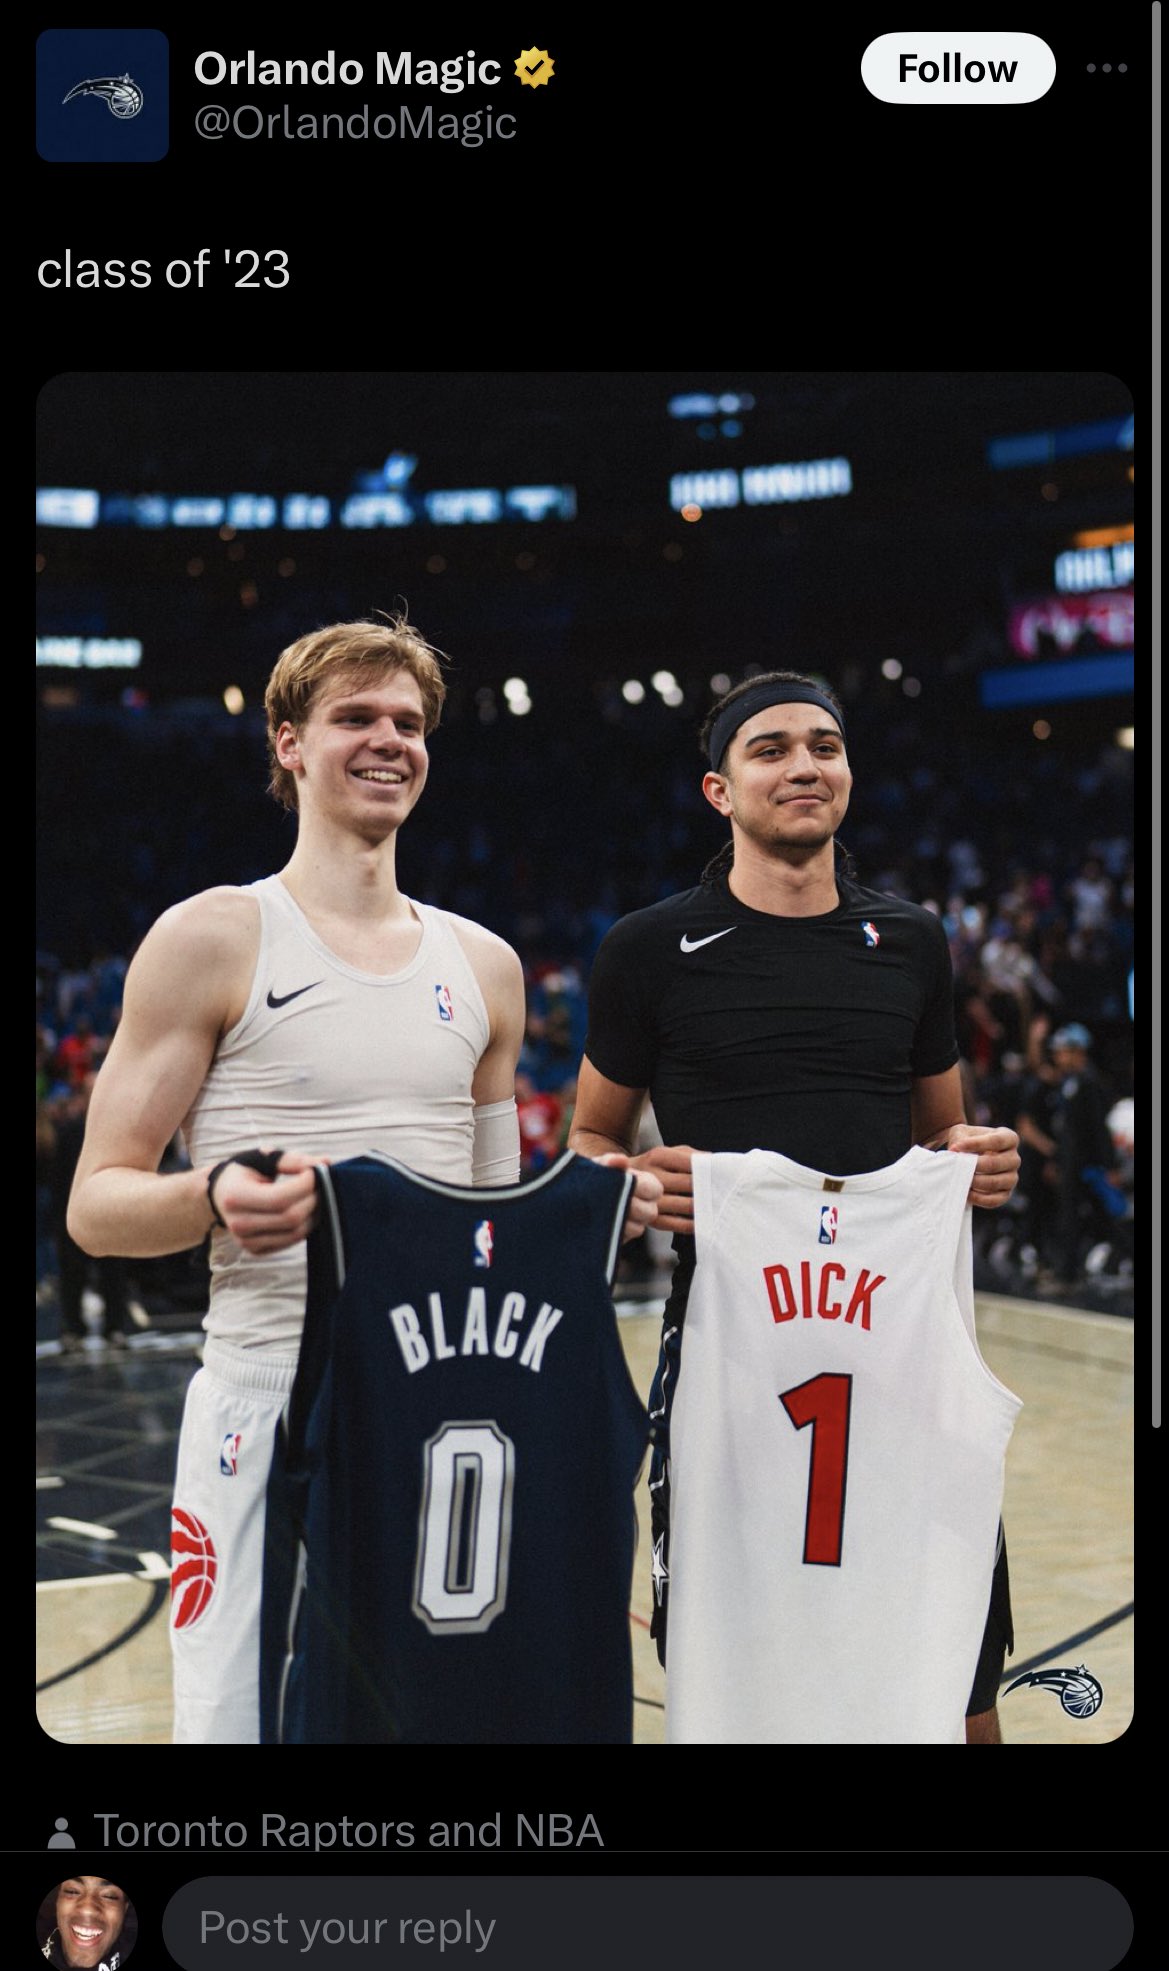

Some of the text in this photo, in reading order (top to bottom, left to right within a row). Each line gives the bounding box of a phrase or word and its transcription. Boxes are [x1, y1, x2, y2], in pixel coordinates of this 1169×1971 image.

[194, 49, 502, 94] Orlando Magic
[898, 51, 1019, 84] Follow
[194, 103, 518, 148] @OrlandoMagic
[37, 248, 290, 289] class of '23
[763, 1261, 887, 1331] DICK
[389, 1286, 564, 1374] BLACK
[778, 1372, 853, 1568] 1
[411, 1419, 516, 1635] 0
[93, 1812, 605, 1851] Toronto Raptors and NBA
[201, 1909, 497, 1953] Post your reply
